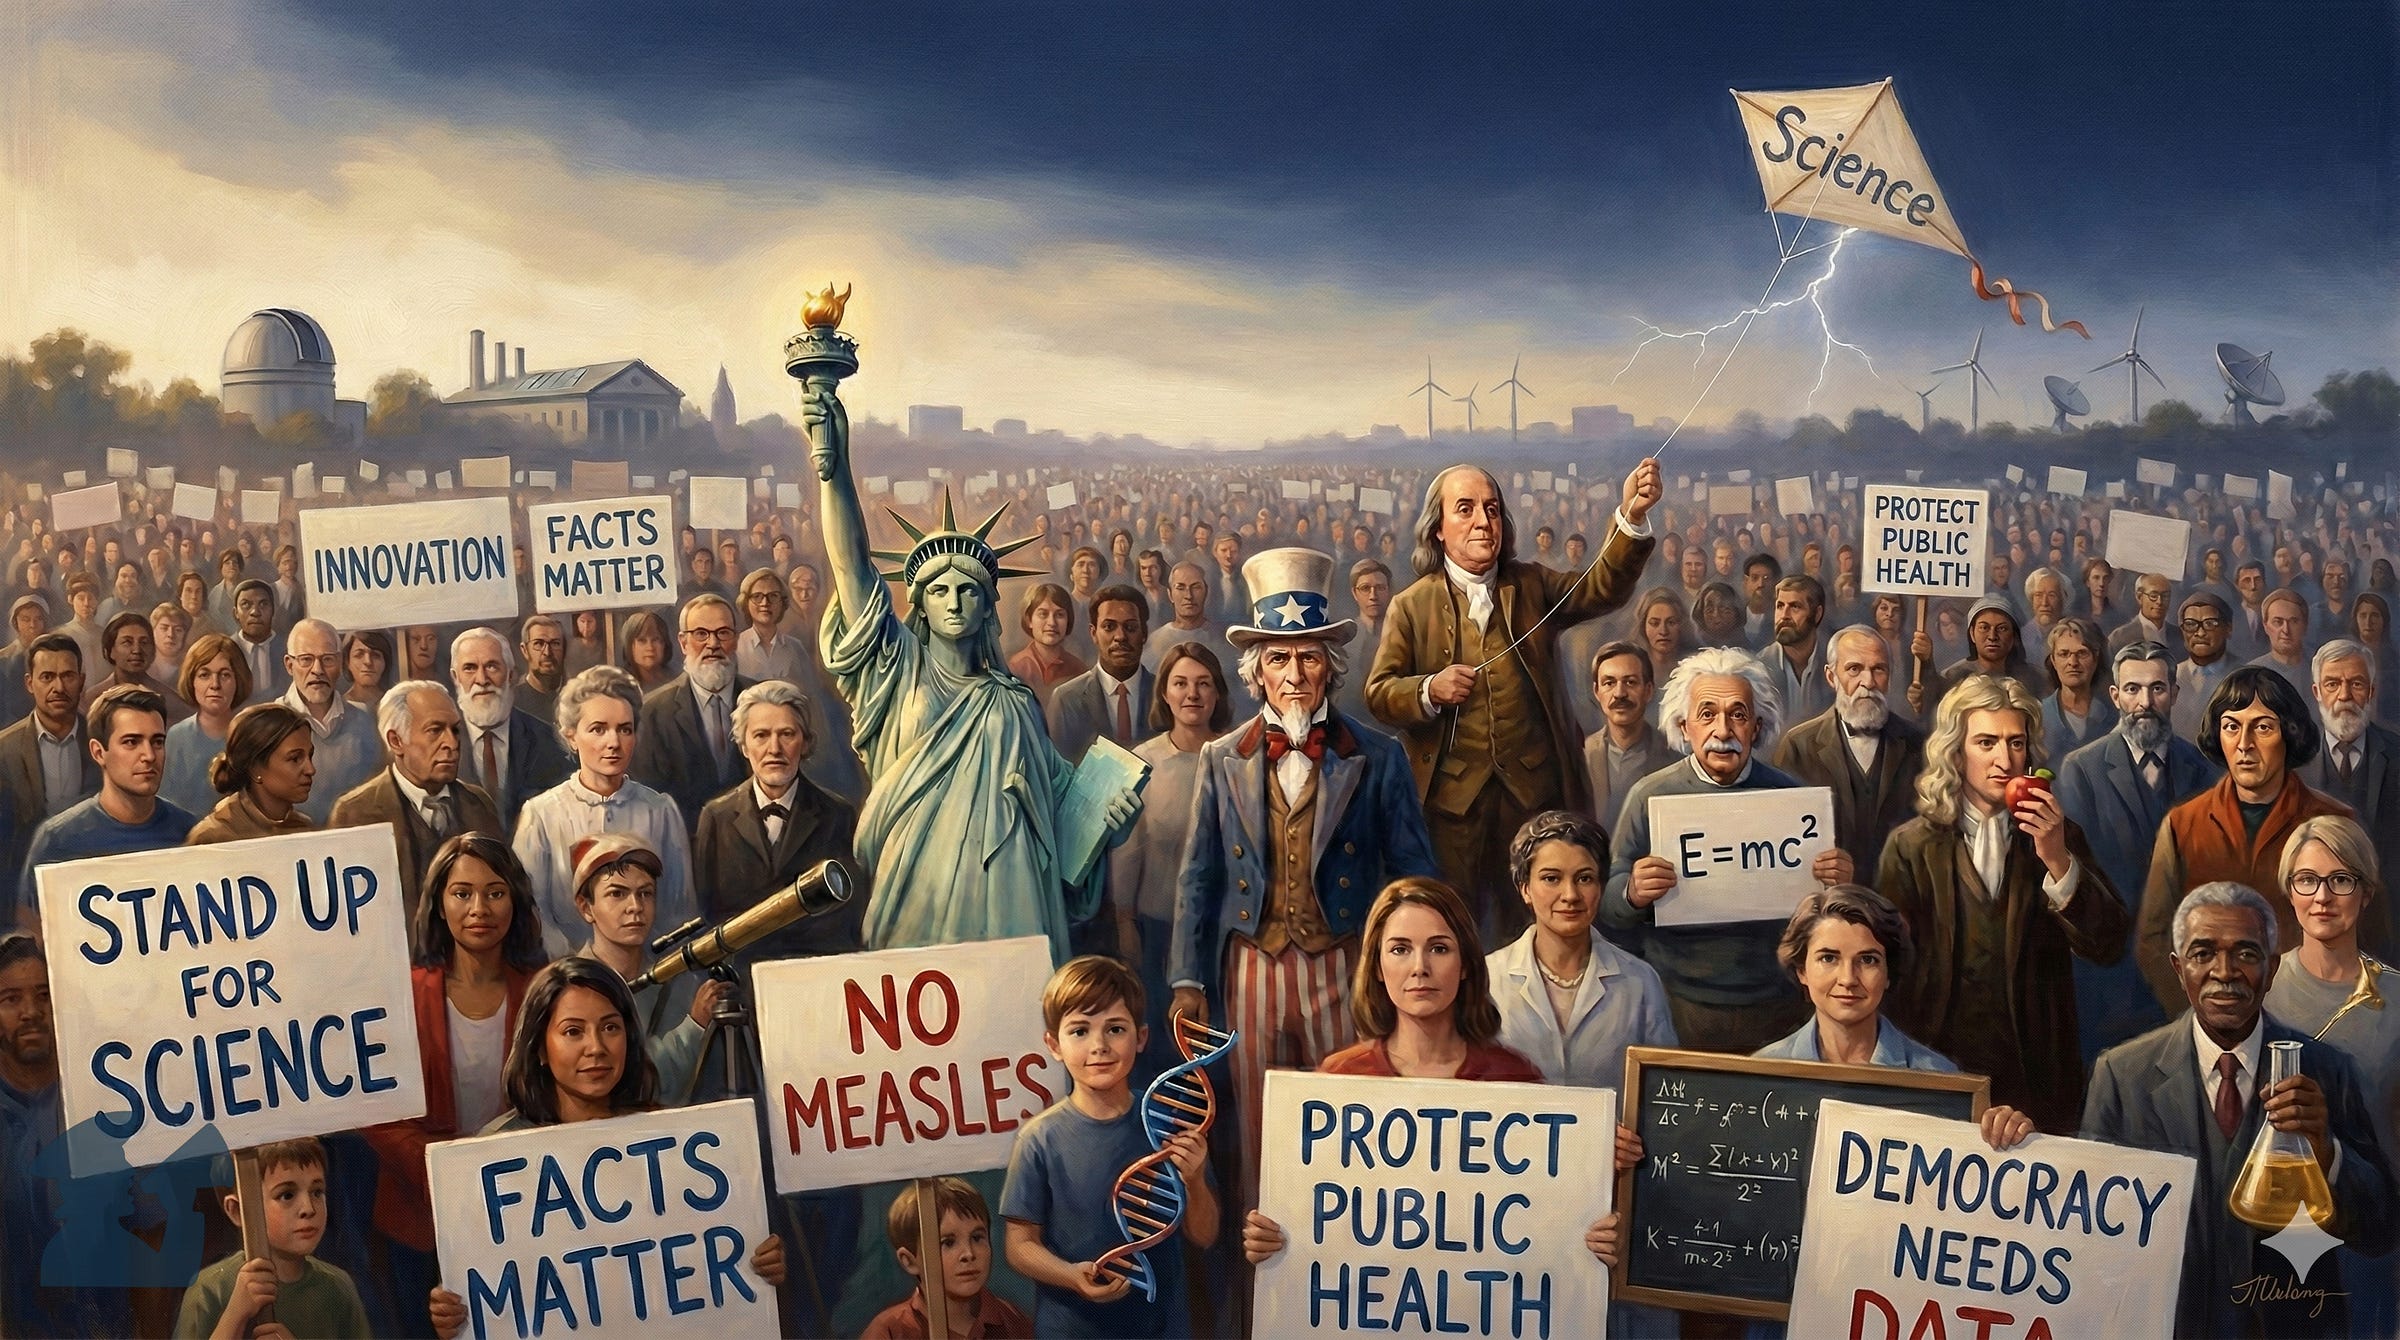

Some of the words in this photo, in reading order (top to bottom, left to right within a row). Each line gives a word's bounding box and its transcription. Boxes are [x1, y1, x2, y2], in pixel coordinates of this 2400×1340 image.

[1762, 105, 1935, 227] Science
[547, 508, 659, 554] FACTS
[1875, 495, 1980, 524] PROTECT
[1882, 527, 1969, 556] PUBLIC
[314, 535, 506, 594] INNOVATION
[544, 554, 667, 598] MATTER
[1876, 557, 1971, 588] HEALTH
[78, 875, 277, 965] STAND
[295, 856, 378, 936] UP
[181, 959, 282, 1019] FOR
[843, 968, 961, 1056] NO
[90, 1007, 397, 1140] SCIENCE
[782, 1052, 1054, 1156] MEASLES
[1301, 1100, 1578, 1178] PROTECT
[480, 1130, 731, 1245] FACTS
[1312, 1182, 1532, 1256] PUBLIC
[1835, 1130, 2173, 1248] DEMOCRACY
[466, 1225, 758, 1340] MATTER
[1310, 1260, 1552, 1340] HEALTH
[1893, 1222, 2073, 1305] NEEDS
[1849, 1288, 2054, 1340] DAT
